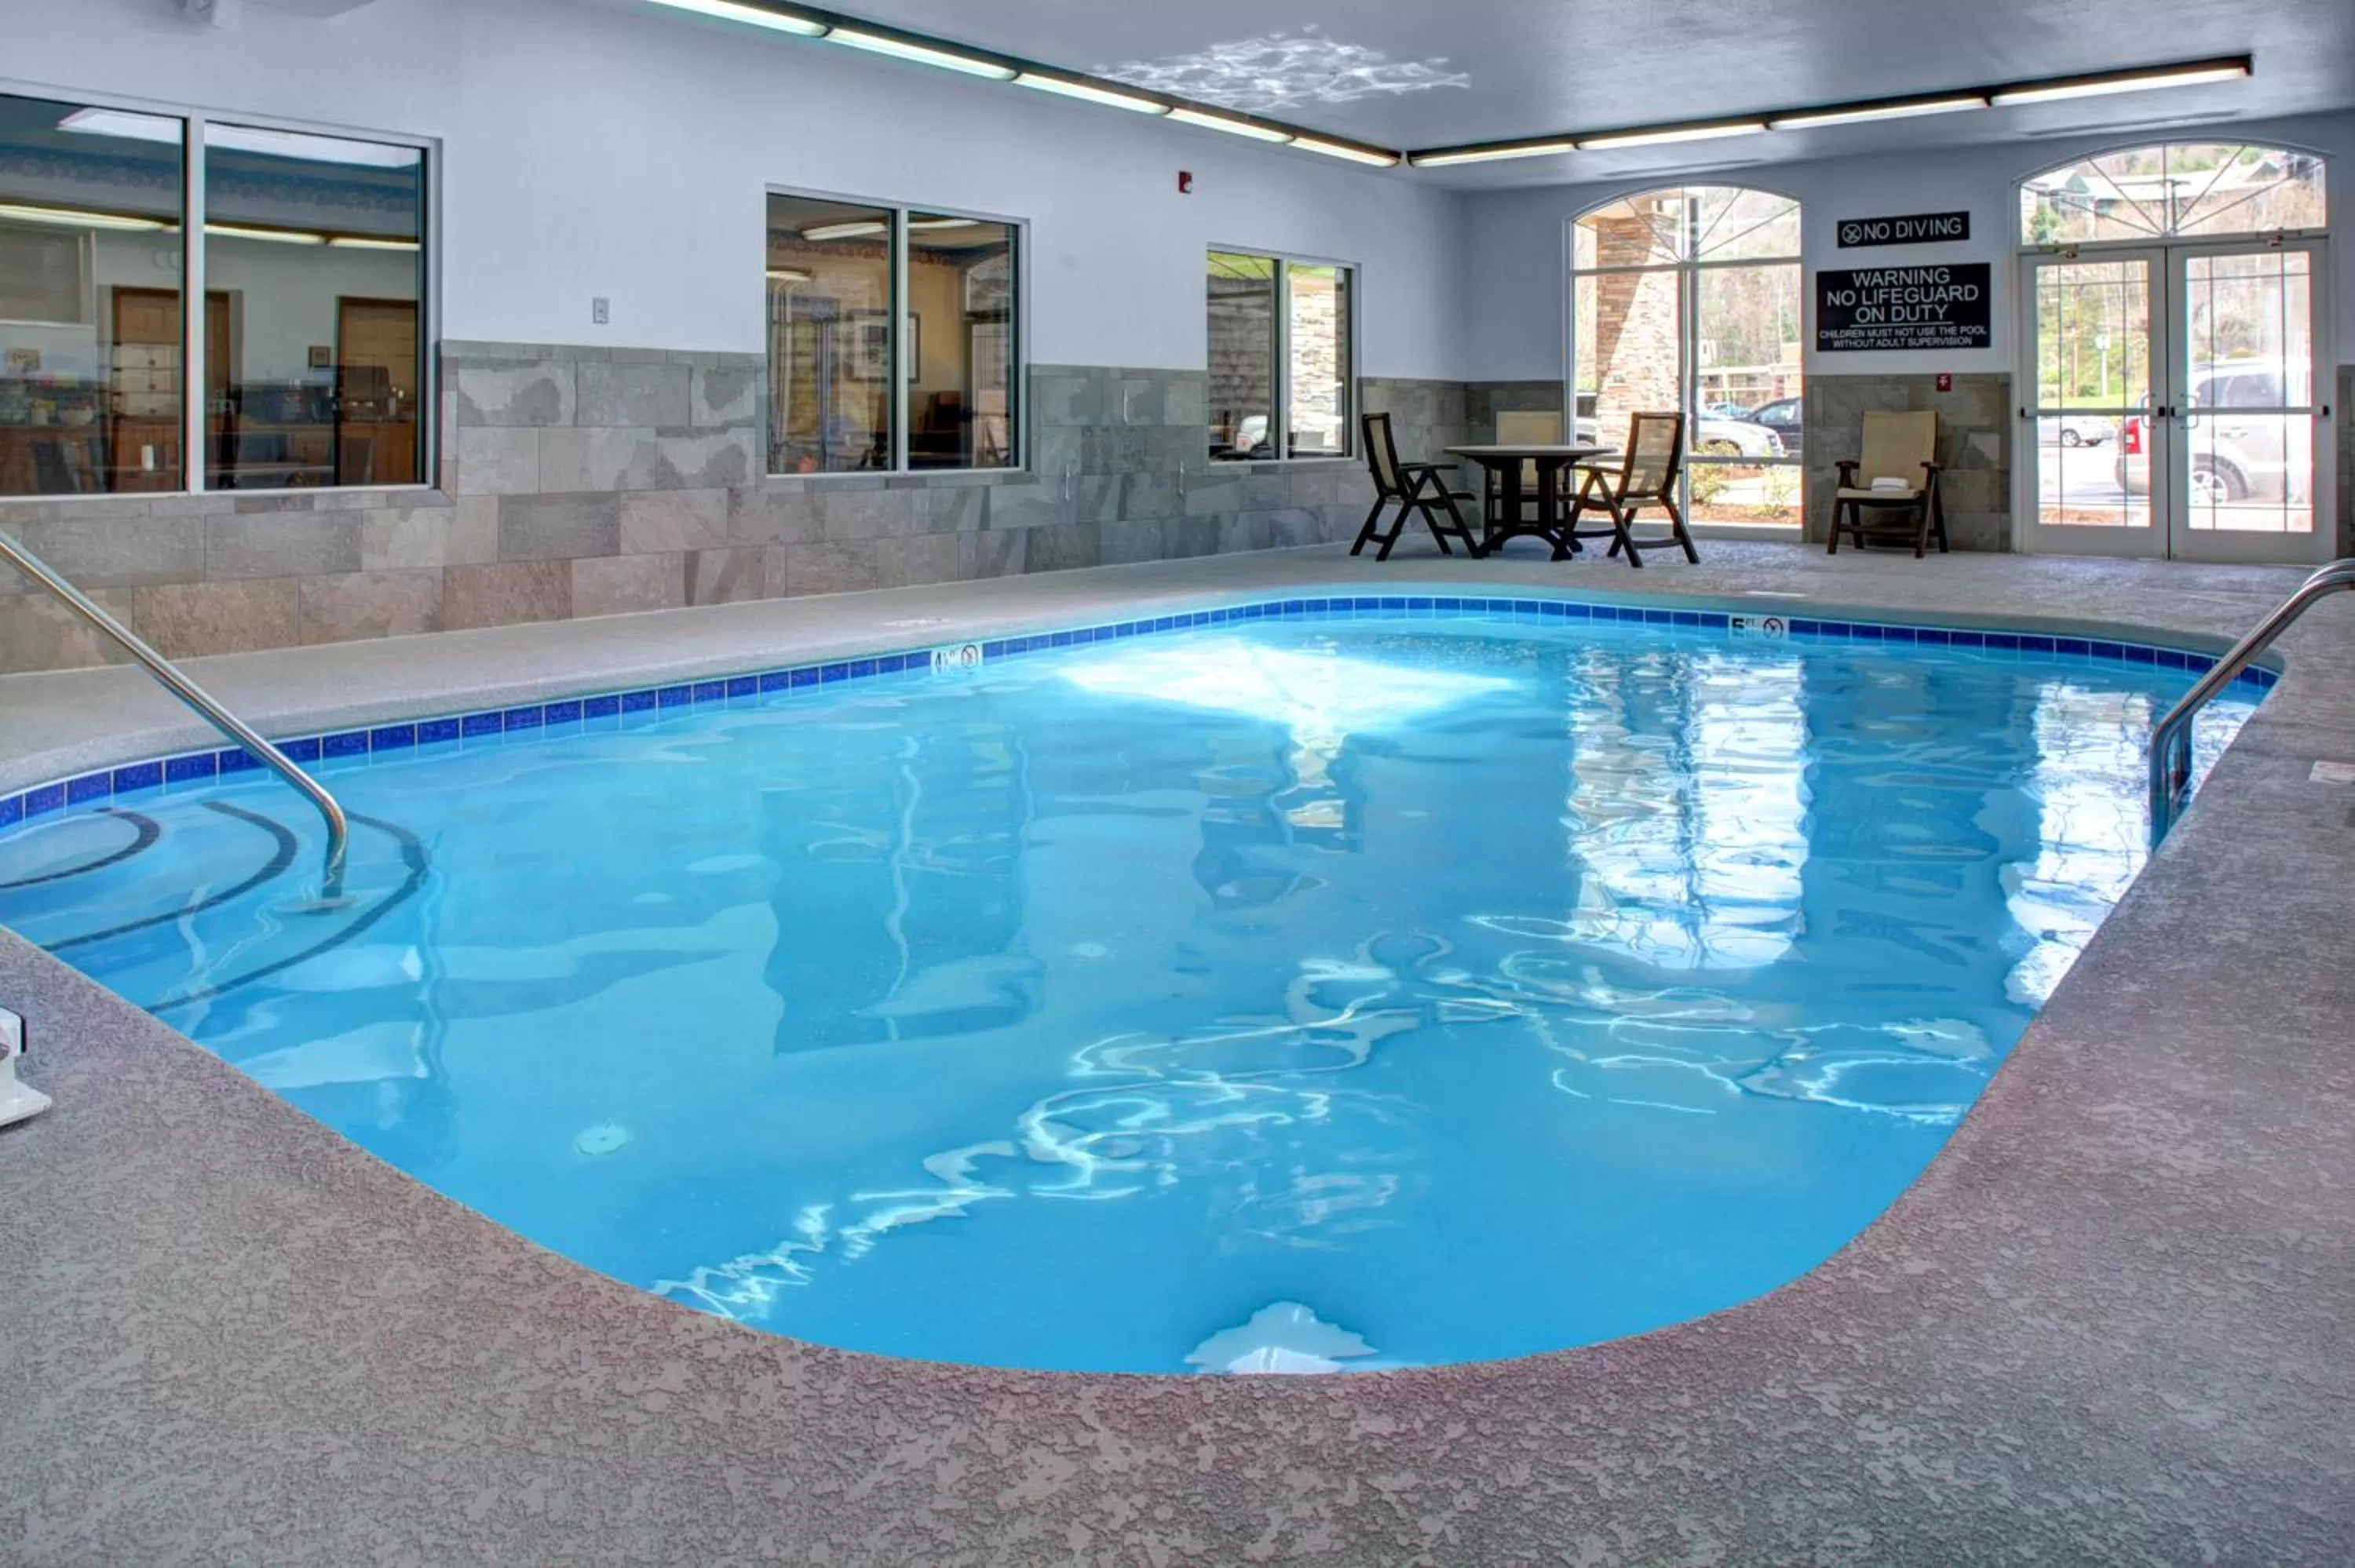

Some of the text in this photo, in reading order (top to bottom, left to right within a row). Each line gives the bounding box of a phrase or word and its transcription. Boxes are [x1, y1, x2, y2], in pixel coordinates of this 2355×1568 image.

[1864, 217, 1962, 239] NO DIVING
[1853, 268, 1950, 287] WARNING
[1827, 285, 1978, 307] NO LIFEGUARD
[1855, 304, 1948, 323] ON DUTY
[1820, 325, 1987, 339] CHILDREN MUST NOT USE THE POOL
[1833, 336, 1972, 348] WITHOUT ADULT SUPERVISION
